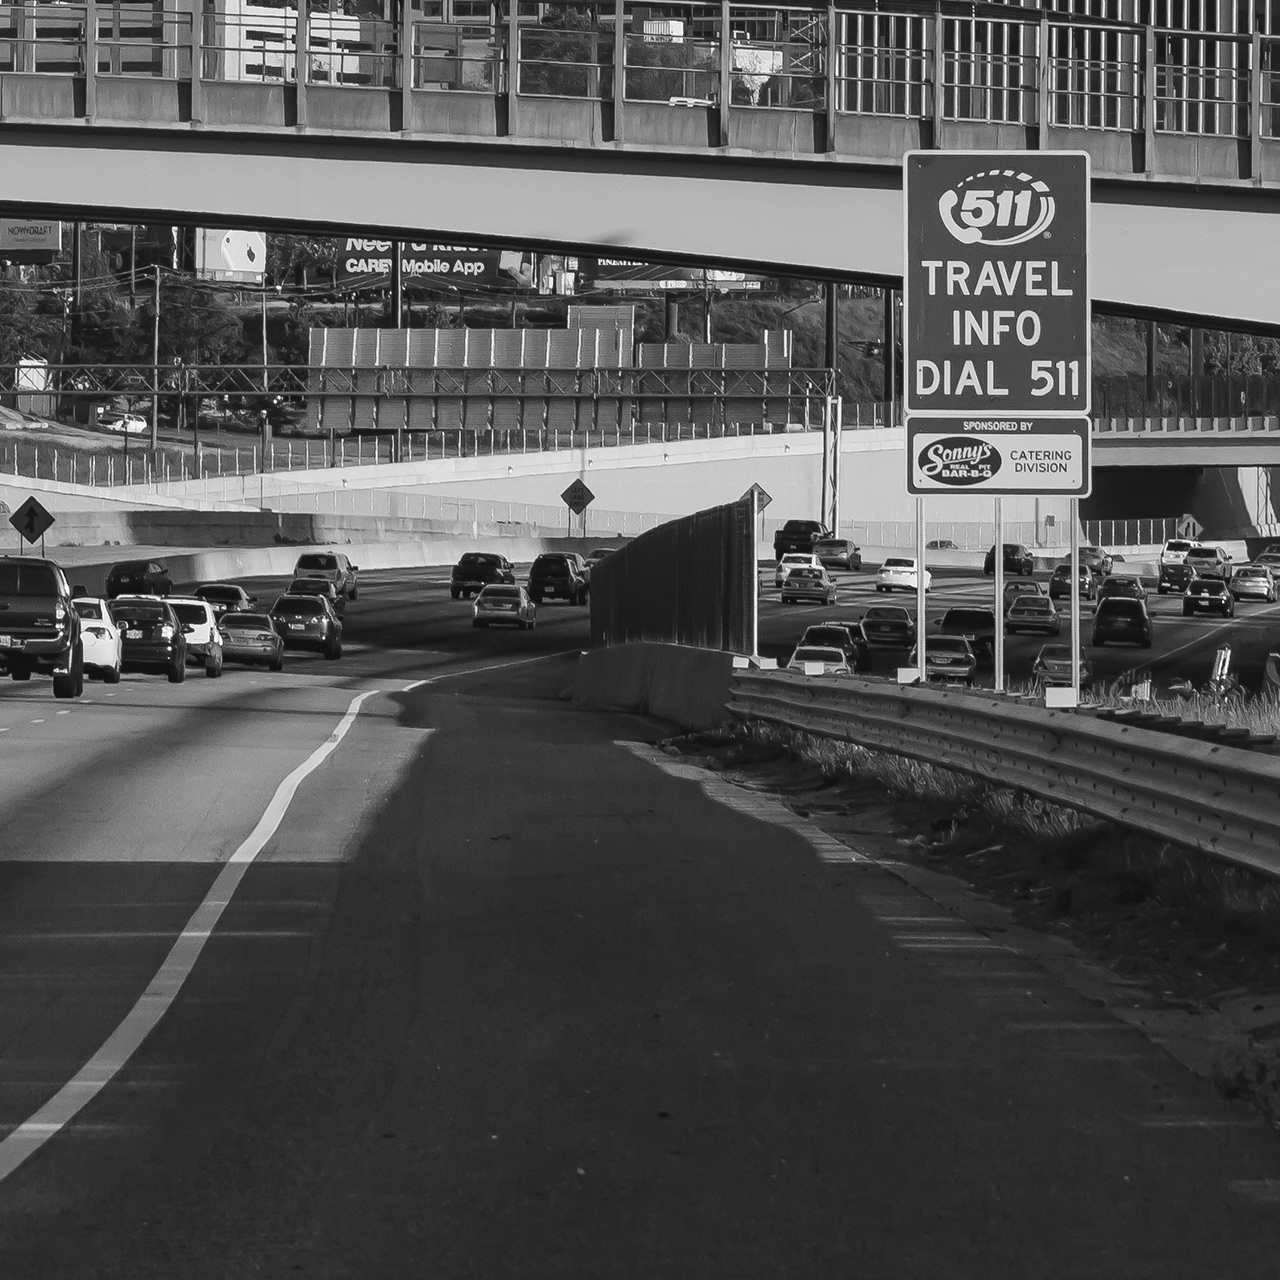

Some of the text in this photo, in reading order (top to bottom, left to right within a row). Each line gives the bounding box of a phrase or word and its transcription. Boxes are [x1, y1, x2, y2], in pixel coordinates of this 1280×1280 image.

[960, 190, 1032, 227] 511
[402, 259, 450, 273] Mobile
[453, 260, 485, 276] App
[921, 260, 1073, 296] TRAVEL
[953, 310, 1041, 346] INFO
[916, 360, 1079, 396] DIAL 511
[963, 421, 1033, 431] SPONSORED BY
[922, 442, 993, 476] Sonny's
[1010, 450, 1072, 461] CATERING
[1015, 462, 1067, 473] DIVISION
[941, 470, 992, 478] BAR-B-Q
